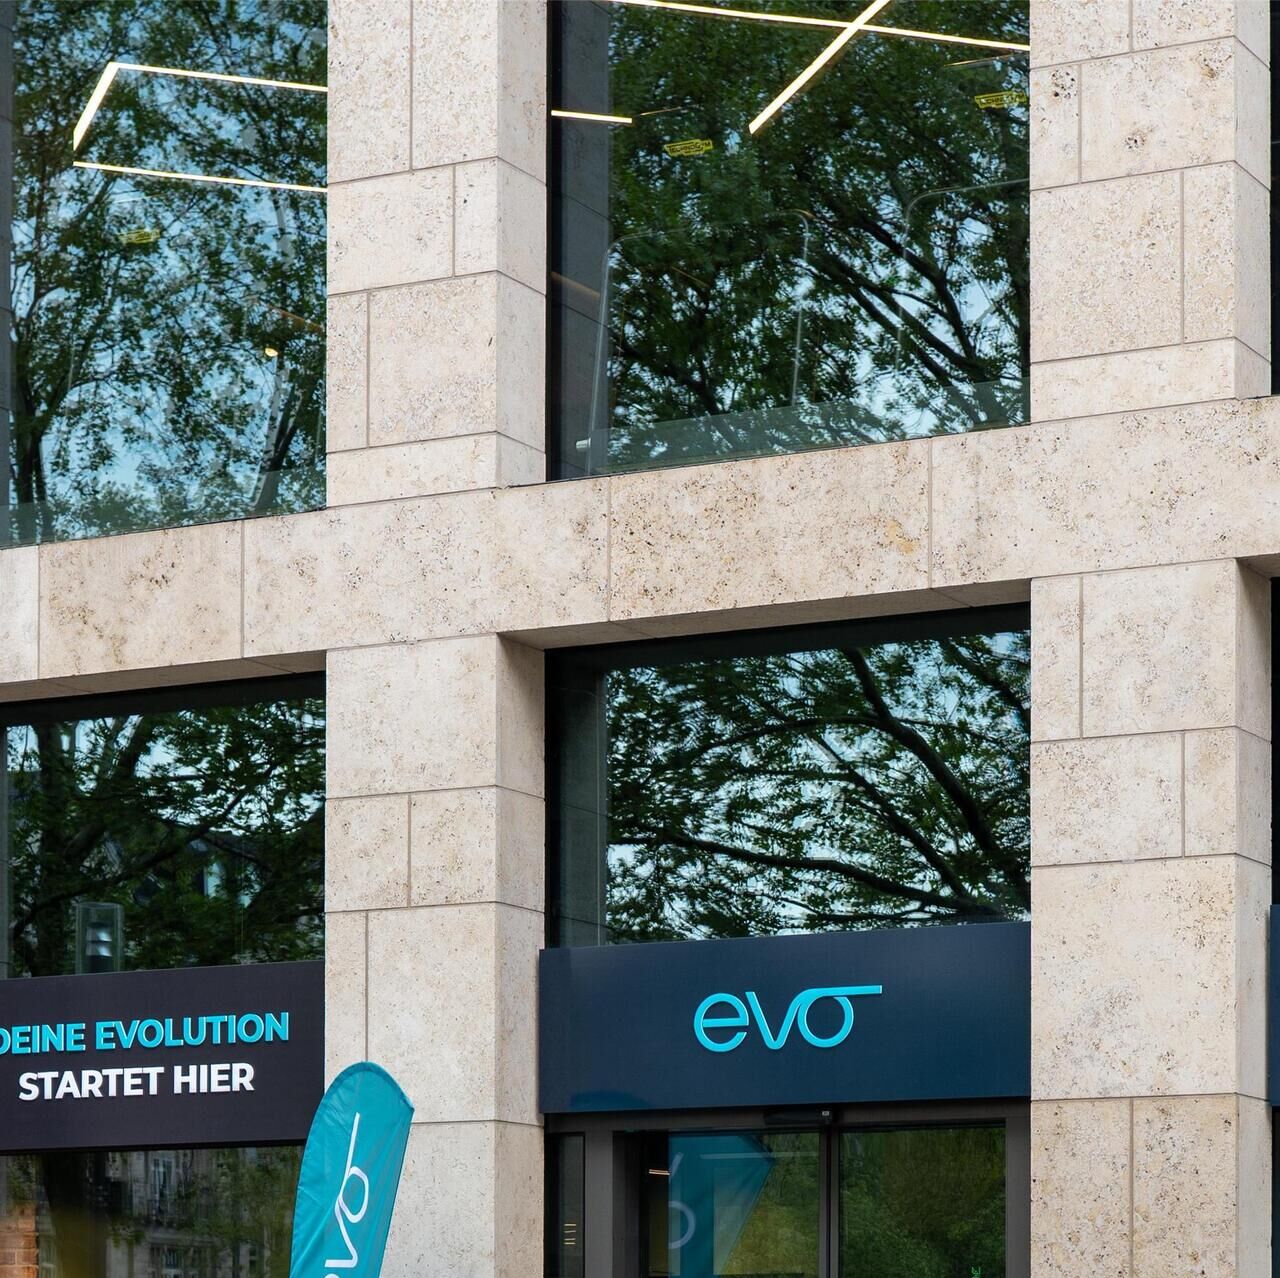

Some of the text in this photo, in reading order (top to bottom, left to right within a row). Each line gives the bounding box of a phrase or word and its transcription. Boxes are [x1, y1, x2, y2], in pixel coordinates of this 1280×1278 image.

[95, 1011, 290, 1050] EVOLUTION
[693, 984, 883, 1053] evo
[19, 1062, 255, 1101] STARTET HIER
